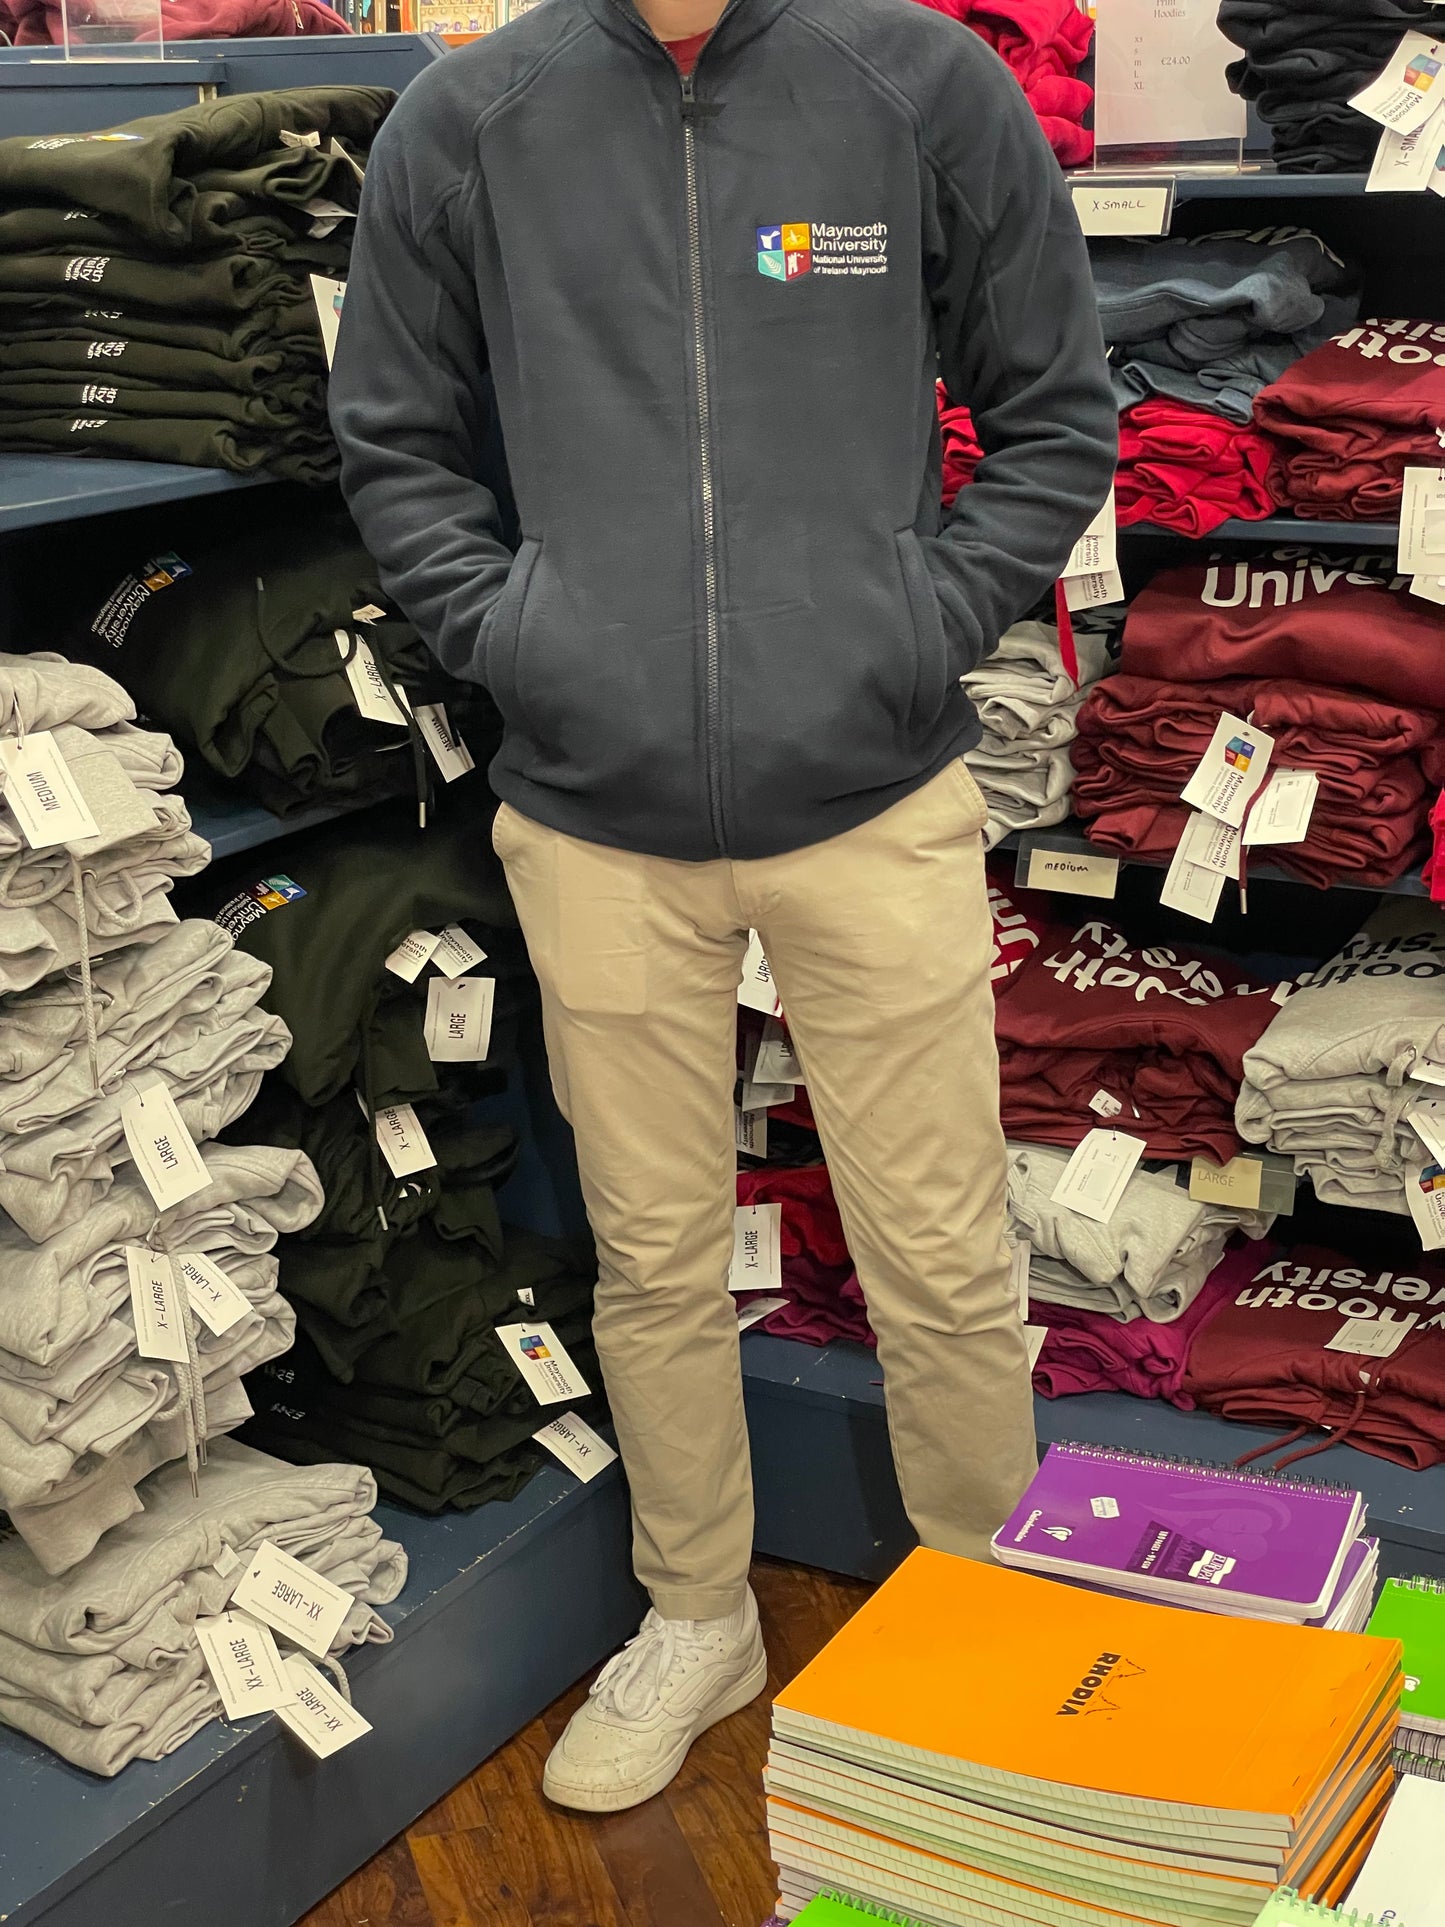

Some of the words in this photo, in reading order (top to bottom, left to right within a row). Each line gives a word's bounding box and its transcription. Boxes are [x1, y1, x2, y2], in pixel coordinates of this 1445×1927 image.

[1153, 9, 1186, 18] Hoodies
[1161, 56, 1191, 66] €24.00
[1133, 82, 1144, 90] XL
[1382, 91, 1416, 119] University
[1389, 94, 1423, 123] Maynooth
[811, 222, 887, 240] Maynooth
[811, 237, 887, 253] University
[812, 254, 845, 264] National
[846, 254, 887, 265] University
[813, 266, 821, 274] of
[822, 266, 849, 275] Ireland
[850, 265, 888, 276] Maynooth
[104, 584, 146, 643] University
[112, 589, 151, 648] Maynooth
[364, 659, 388, 702] X-LARGE
[26, 770, 61, 812] MEDIUM
[1213, 772, 1239, 811] University
[1218, 774, 1245, 814] Maynooth
[447, 1013, 467, 1039] LARGE
[383, 1108, 411, 1151] X-LARGE
[153, 1135, 179, 1170] LARGE
[1197, 1170, 1236, 1188] LARGE
[744, 1230, 759, 1269] X-LARGE
[180, 1262, 222, 1302] X-LARGE
[151, 1279, 169, 1330] X-LARGE
[543, 1360, 567, 1396] University
[549, 1359, 573, 1394] Maynooth
[548, 1419, 592, 1458] XX-LARGE
[1196, 1553, 1227, 1583] EUROPA
[271, 1579, 325, 1621] XX-LARGE
[229, 1637, 265, 1691] XX-LARGE
[1055, 1652, 1121, 1715] RHODIA
[296, 1687, 344, 1732] XX-LARGE
